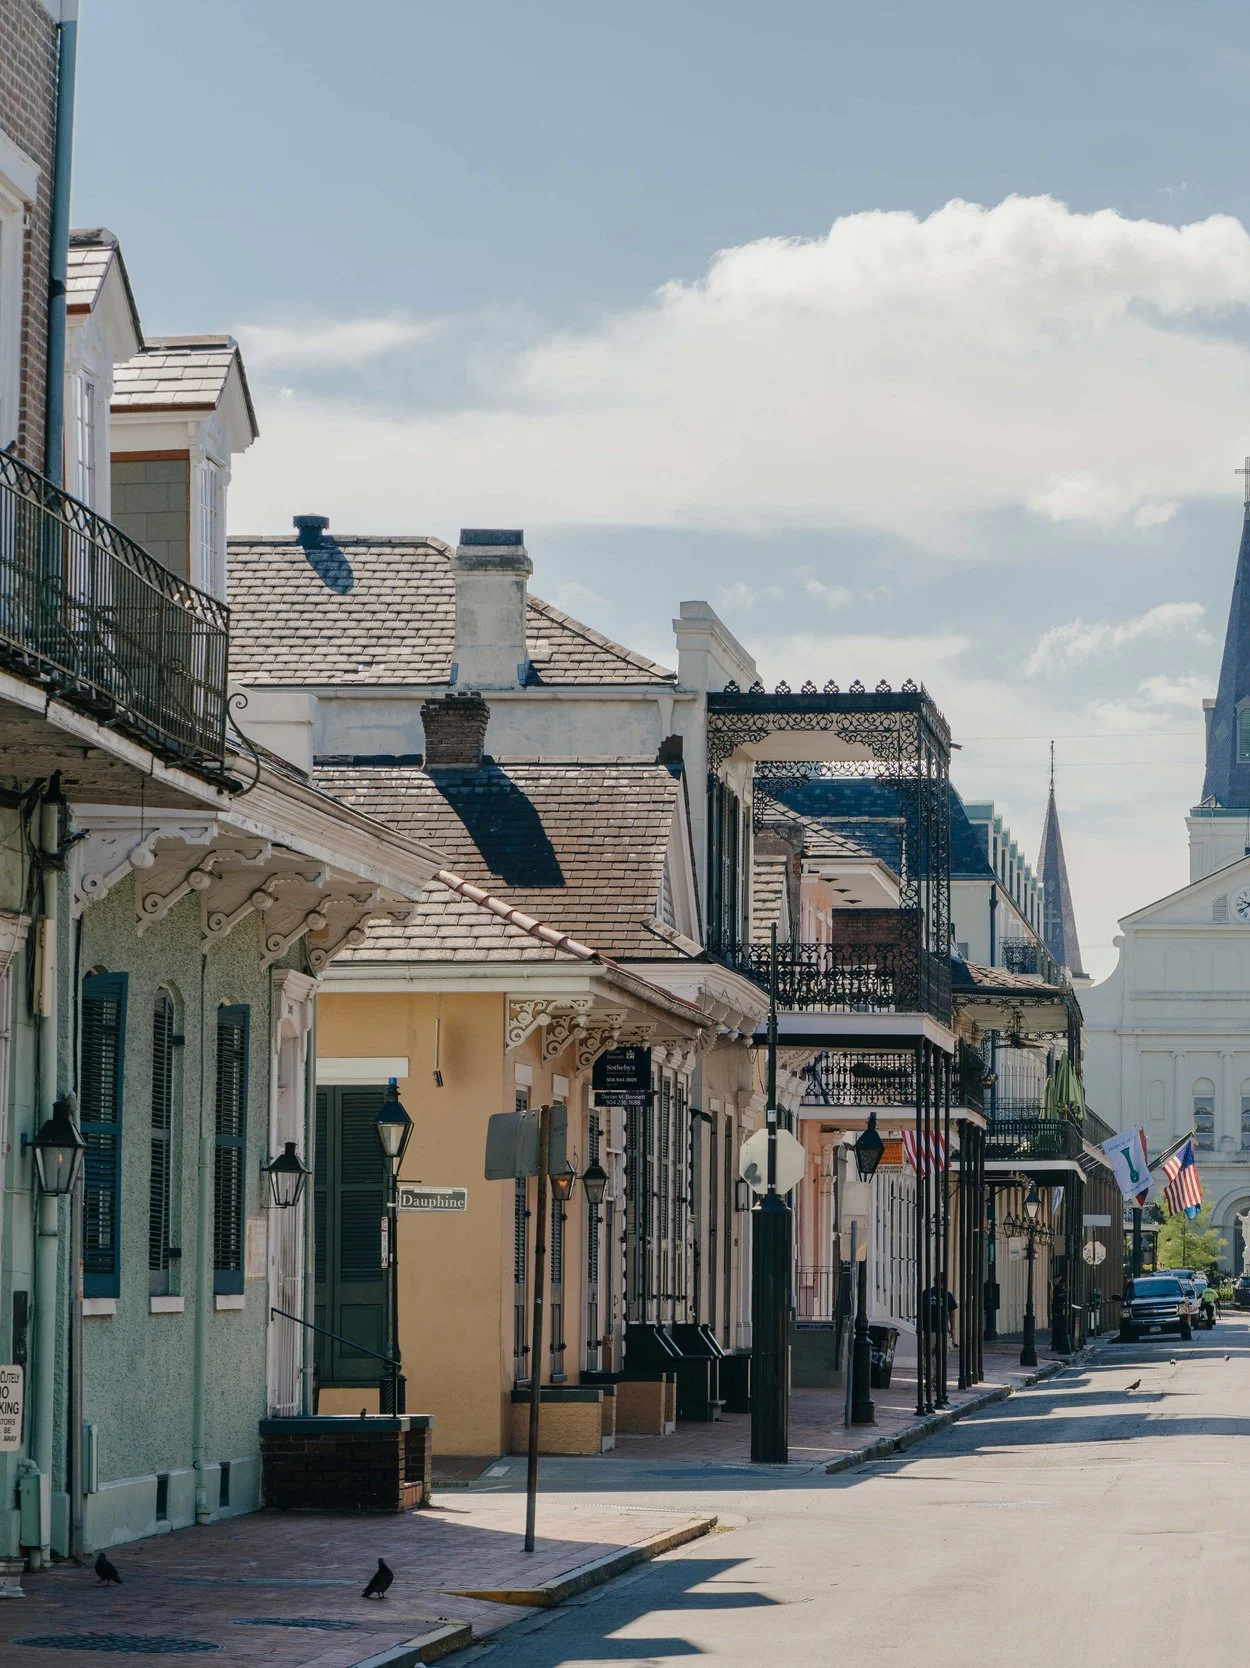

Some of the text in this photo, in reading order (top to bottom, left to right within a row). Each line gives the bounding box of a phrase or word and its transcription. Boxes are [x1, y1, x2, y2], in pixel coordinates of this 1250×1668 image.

[606, 1063, 636, 1072] Sotheby's
[402, 1194, 464, 1209] Dauphine
[0, 1373, 20, 1384] LUTELY
[3, 1426, 12, 1434] BE
